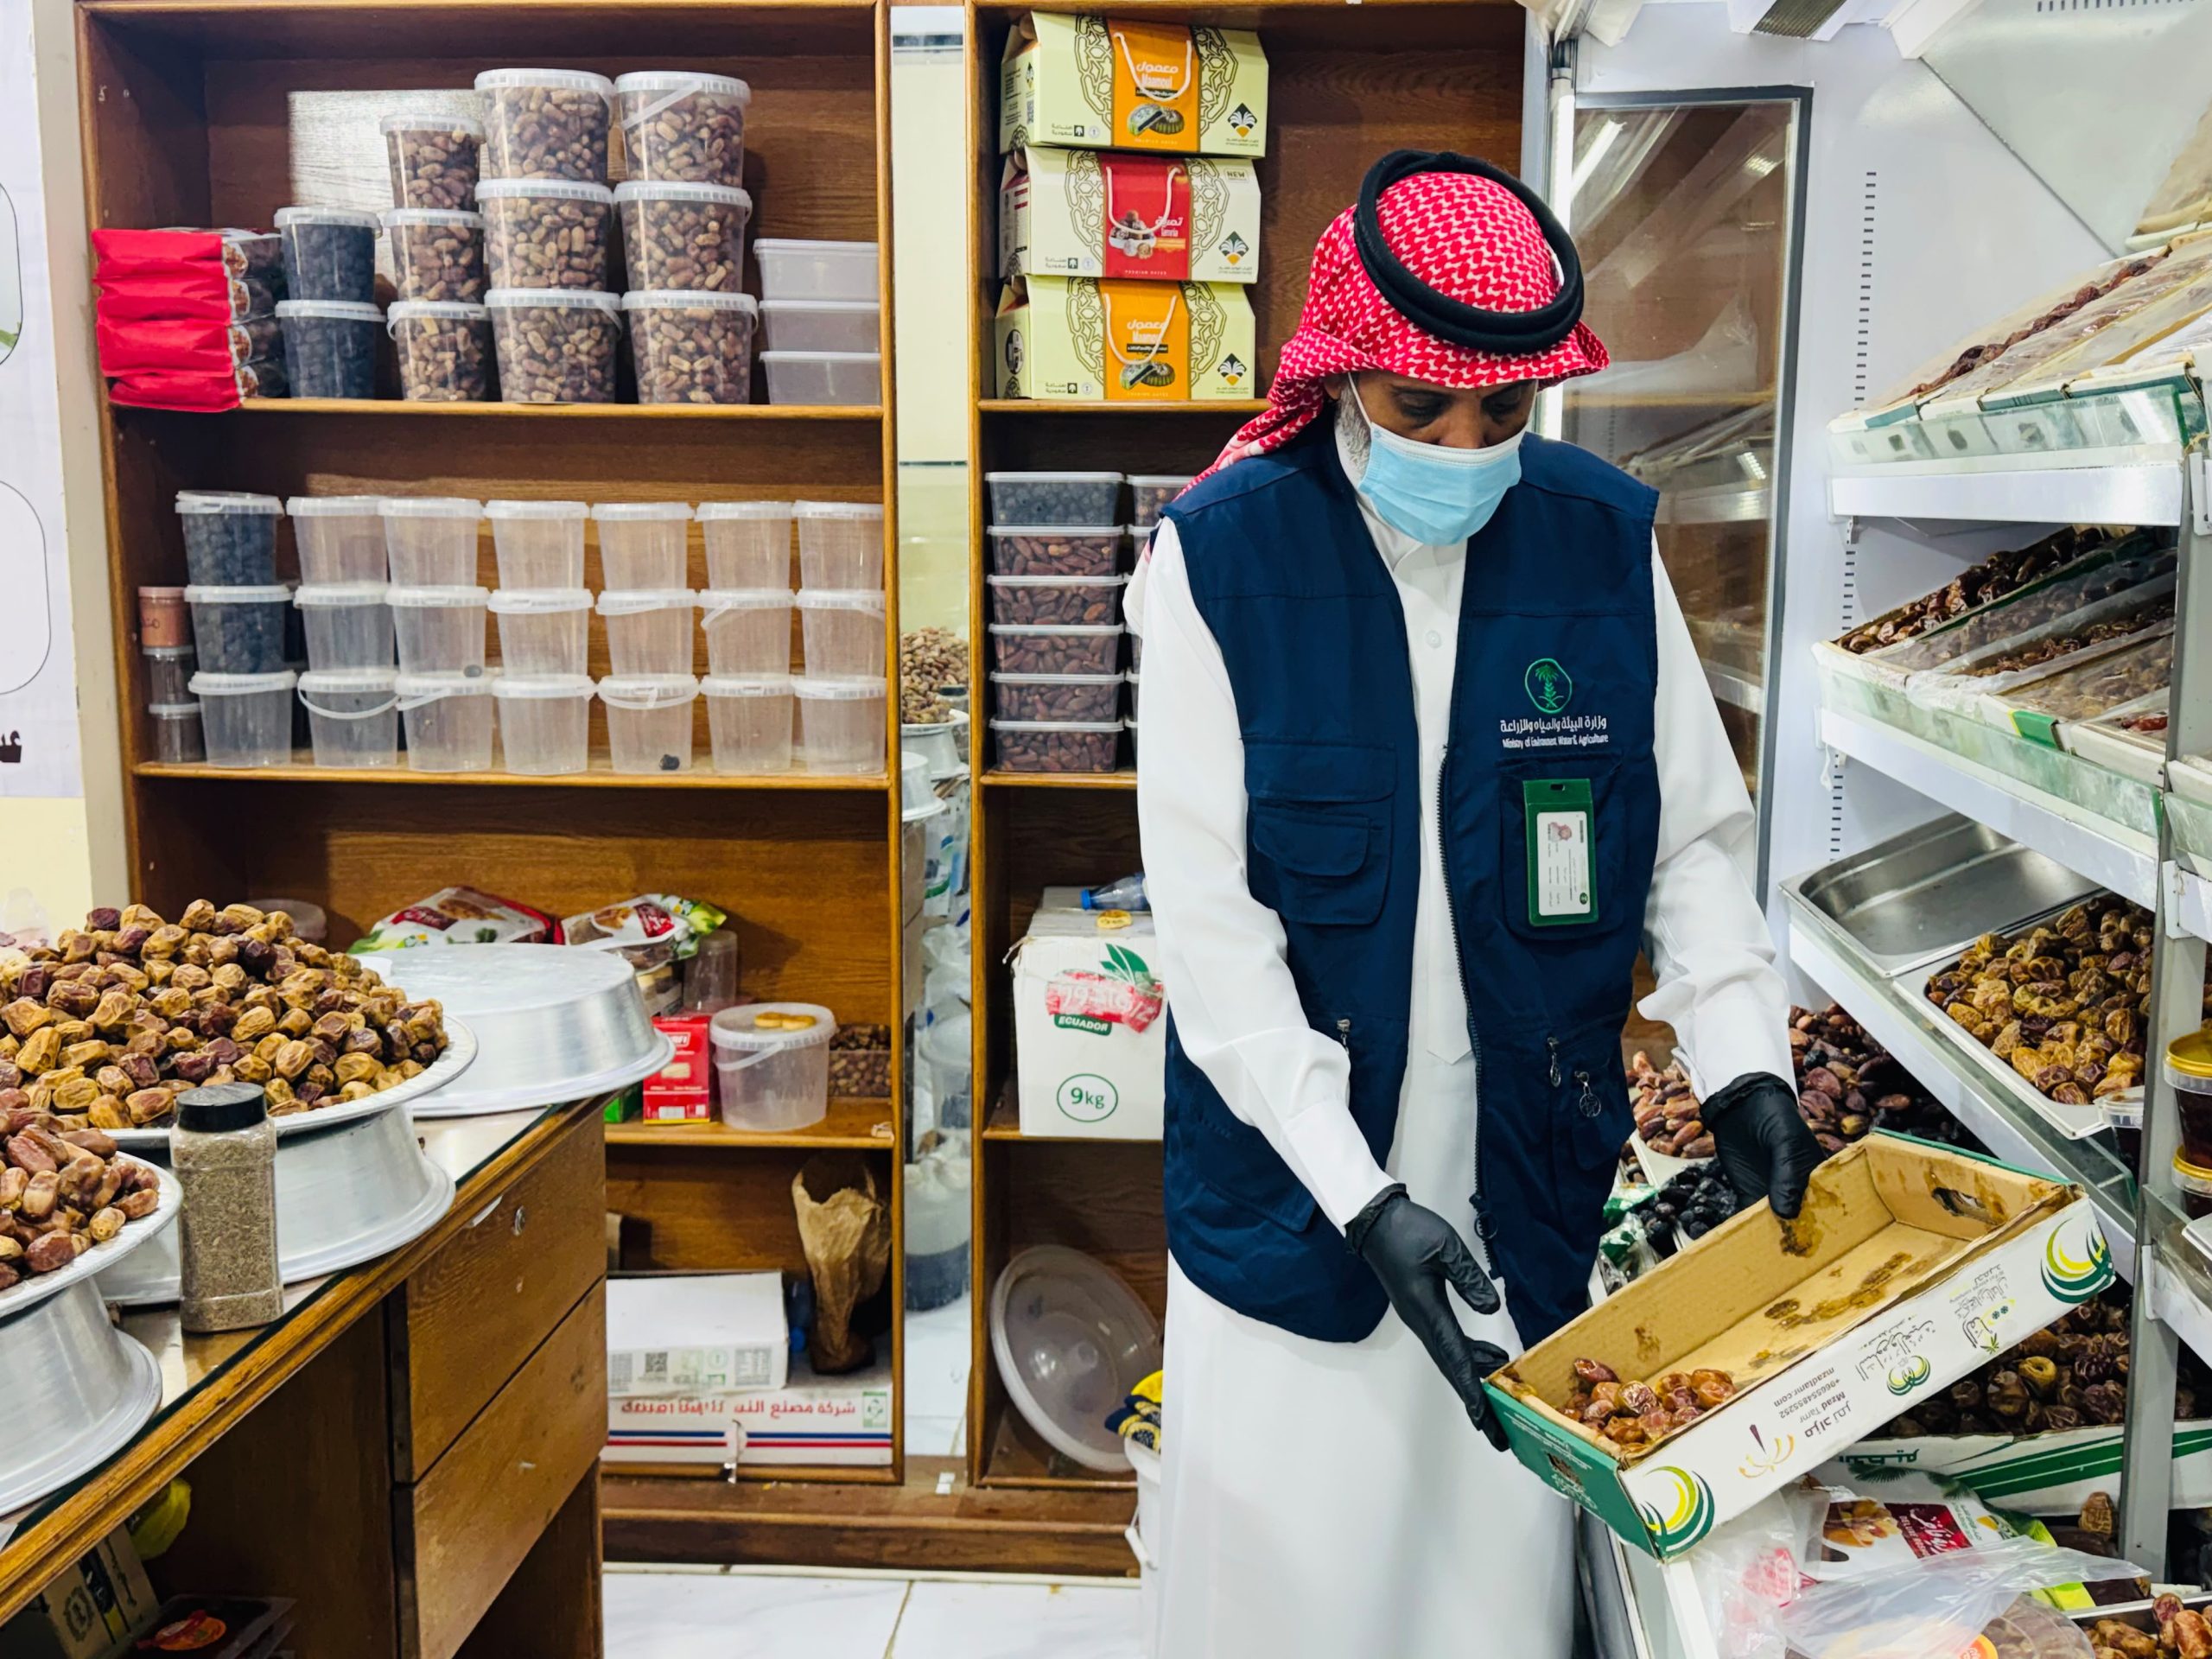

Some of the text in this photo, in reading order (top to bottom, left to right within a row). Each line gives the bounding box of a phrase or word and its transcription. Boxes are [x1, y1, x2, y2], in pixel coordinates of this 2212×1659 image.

[1500, 715, 1607, 734] وزارة البيئة والمياه والزراعة
[1579, 733, 1609, 747] Agriculture
[1058, 1015, 1109, 1033] ECUADOR
[1773, 1367, 1835, 1408] mzadtamr.com
[1779, 1378, 1840, 1420] +966554855252
[770, 1400, 814, 1420] مصنع
[1799, 1391, 1847, 1424] Mzad Tamr
[1804, 1400, 1852, 1438] مزاد تمر
